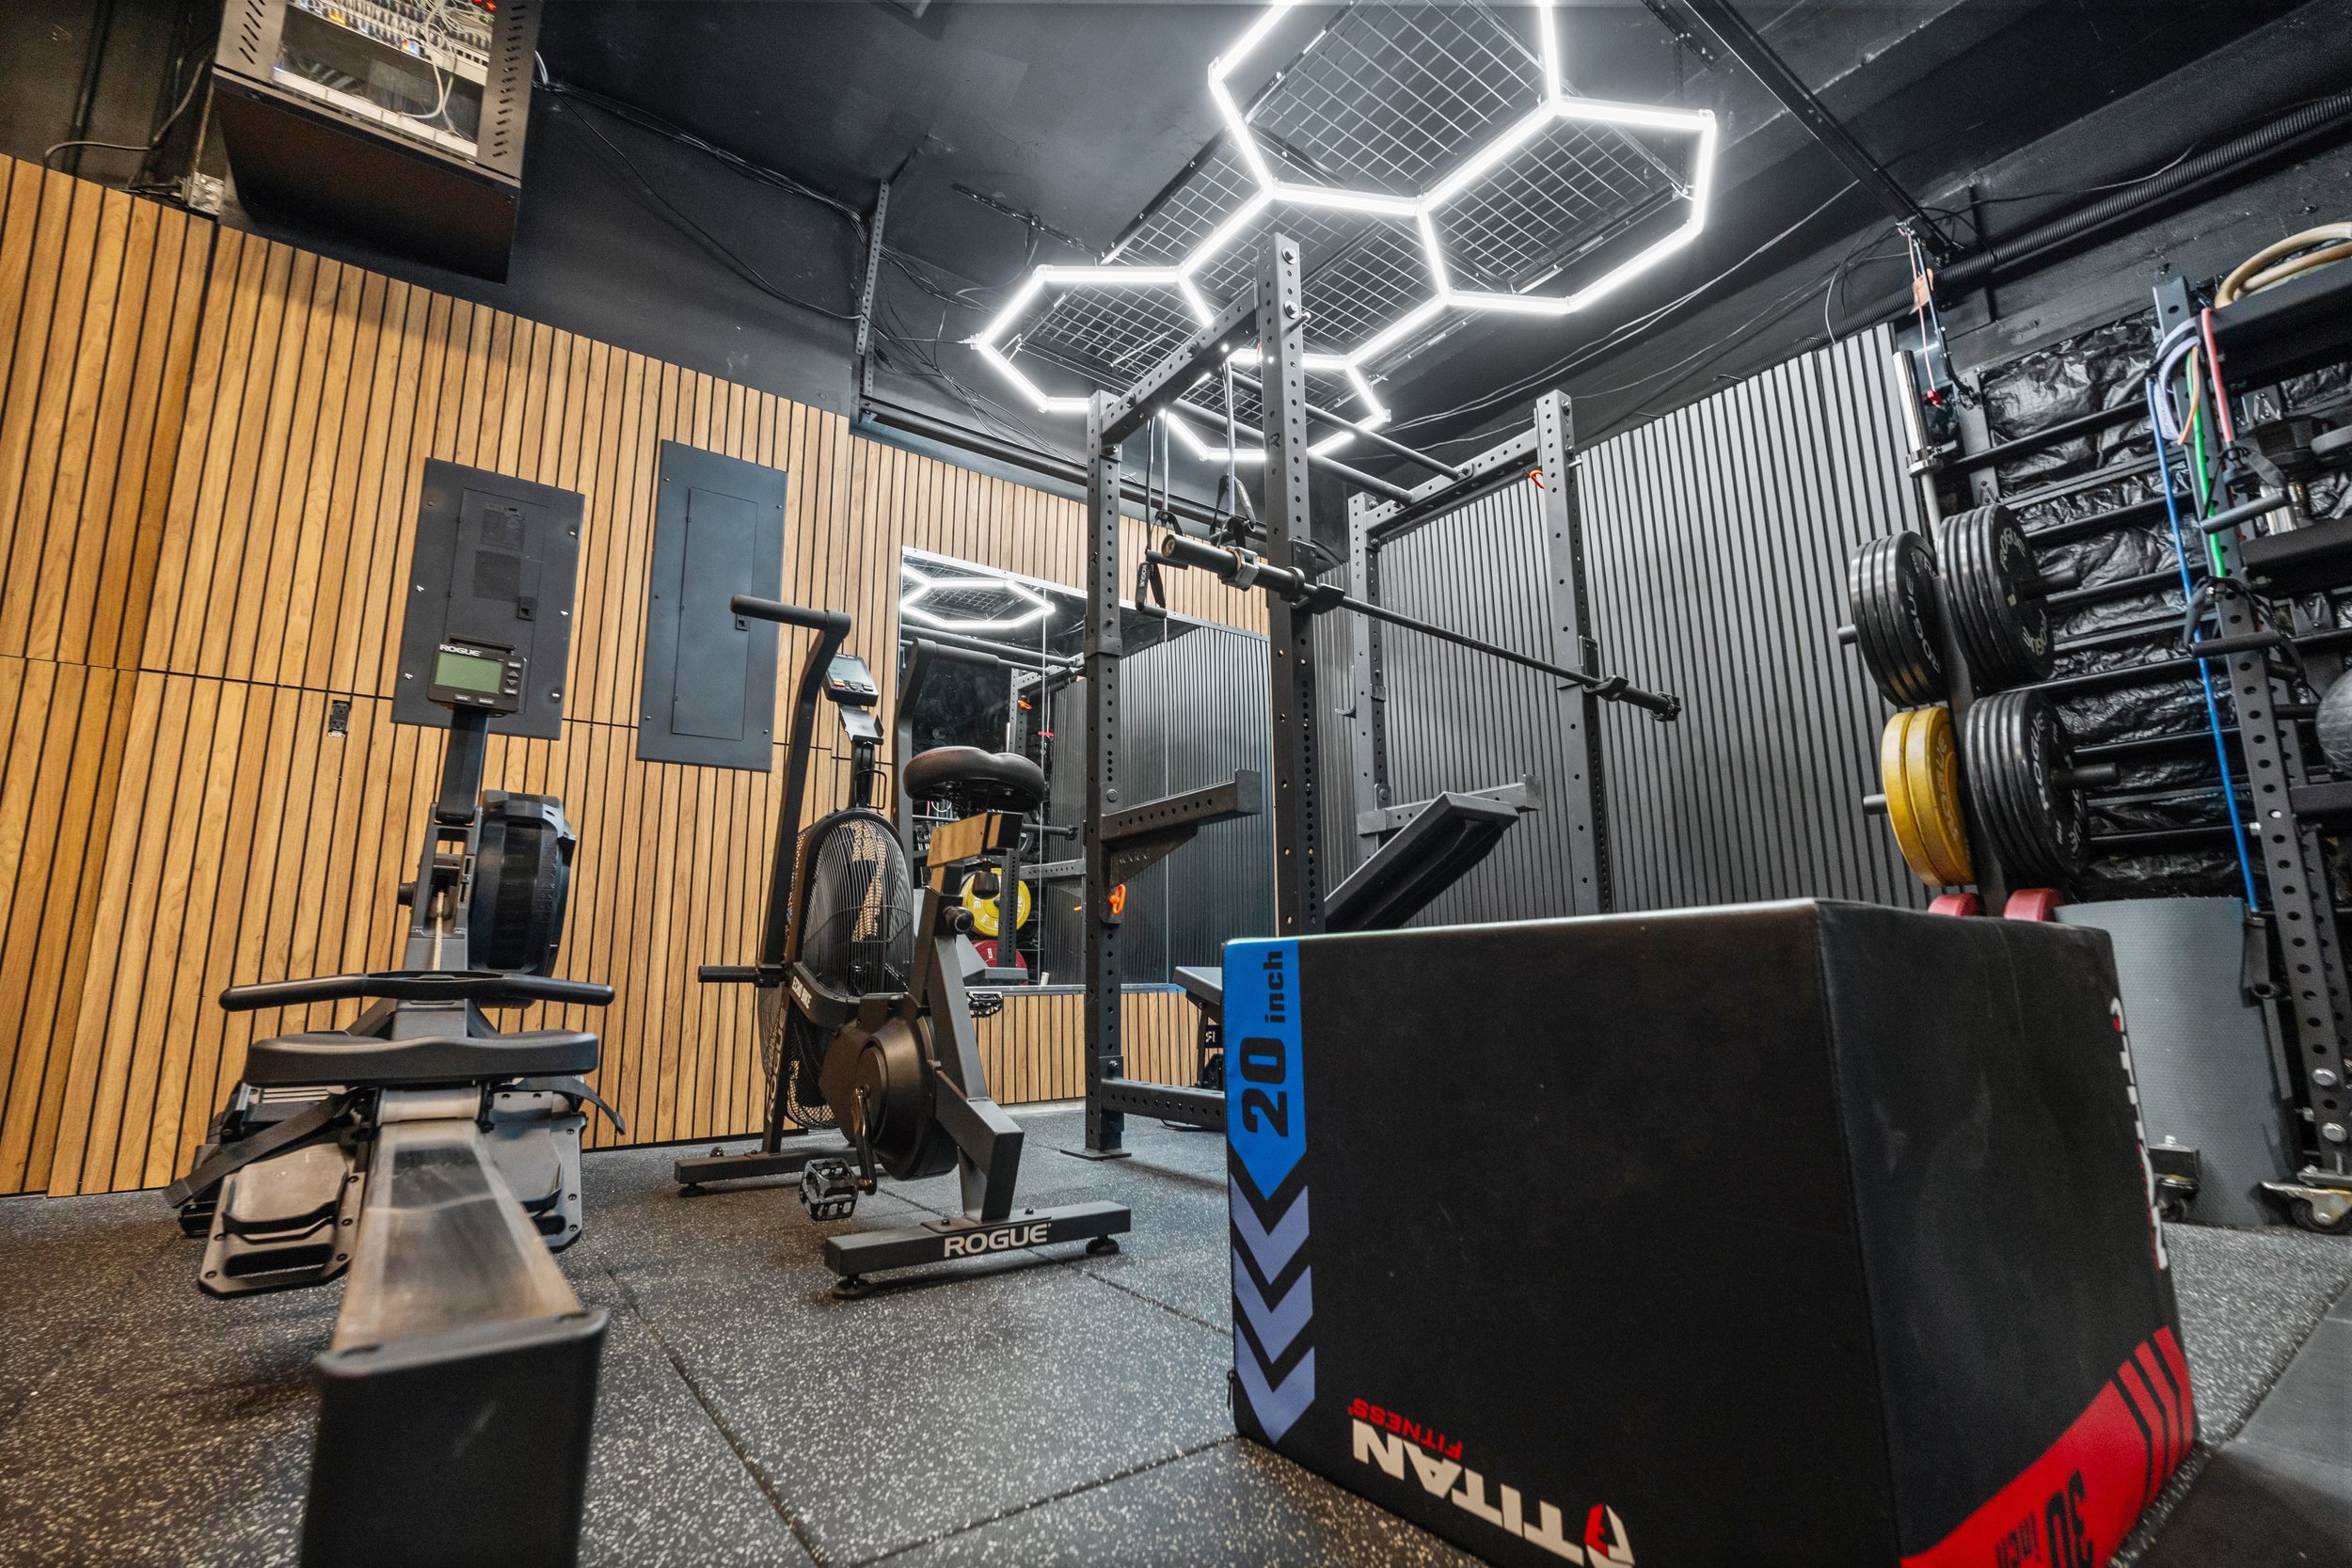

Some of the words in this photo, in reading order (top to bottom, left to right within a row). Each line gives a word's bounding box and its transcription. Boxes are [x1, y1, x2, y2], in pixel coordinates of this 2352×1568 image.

[439, 643, 483, 657] ROGUE
[1905, 571, 1941, 674] ROGUE
[2030, 710, 2050, 811] ROGUE
[1263, 950, 1286, 1023] inch
[767, 1006, 787, 1123] ROGUE
[1239, 1037, 1289, 1138] 20
[944, 1223, 1048, 1259] ROGUE
[1350, 1398, 1463, 1461] FITNESS
[1352, 1418, 1584, 1567] TITAN
[2045, 1468, 2094, 1568] 30
